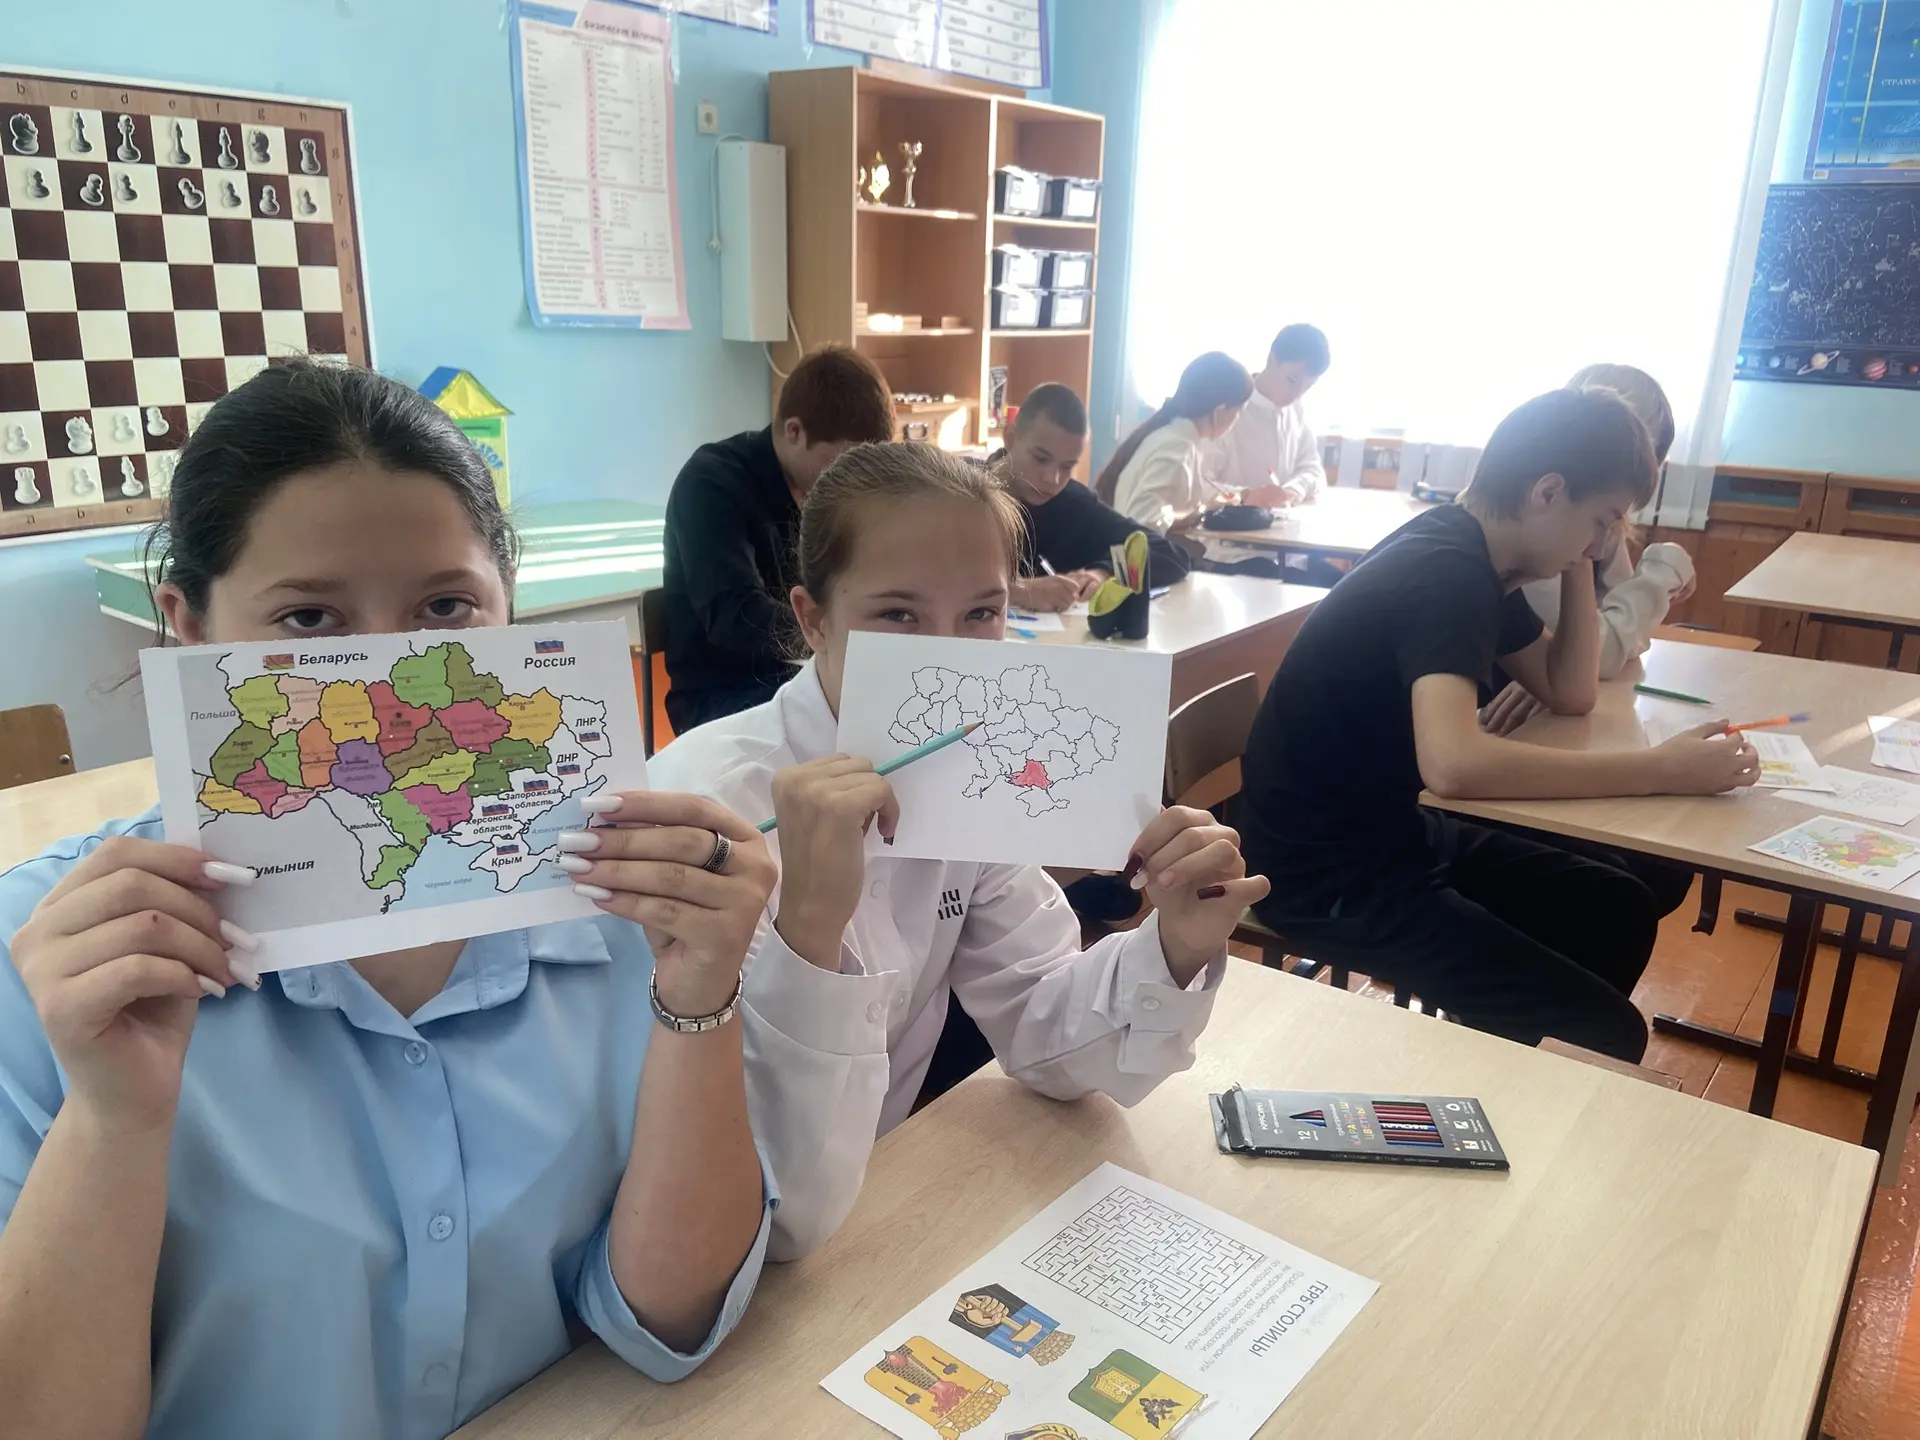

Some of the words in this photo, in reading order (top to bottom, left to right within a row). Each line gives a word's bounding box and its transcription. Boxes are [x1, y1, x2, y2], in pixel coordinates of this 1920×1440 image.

[299, 652, 369, 666] Беларусь
[524, 656, 576, 669] Россия
[190, 710, 237, 721] Польша
[575, 717, 597, 728] ЛНР
[556, 752, 579, 764] ДНР
[505, 788, 561, 800] Запорожская
[515, 800, 554, 809] область
[466, 813, 518, 826] Херсонская
[473, 824, 513, 835] область
[491, 855, 523, 868] Крым
[246, 860, 315, 879] умыния
[1298, 1130, 1312, 1141] 12
[1300, 1280, 1329, 1305] ГЕРБ
[1197, 1307, 1230, 1336] определить
[1249, 1304, 1305, 1357] СТОЛИЦЫ
[1184, 1336, 1200, 1351] герб
[1212, 1326, 1248, 1360] правильном
[1199, 1358, 1215, 1373] пути
